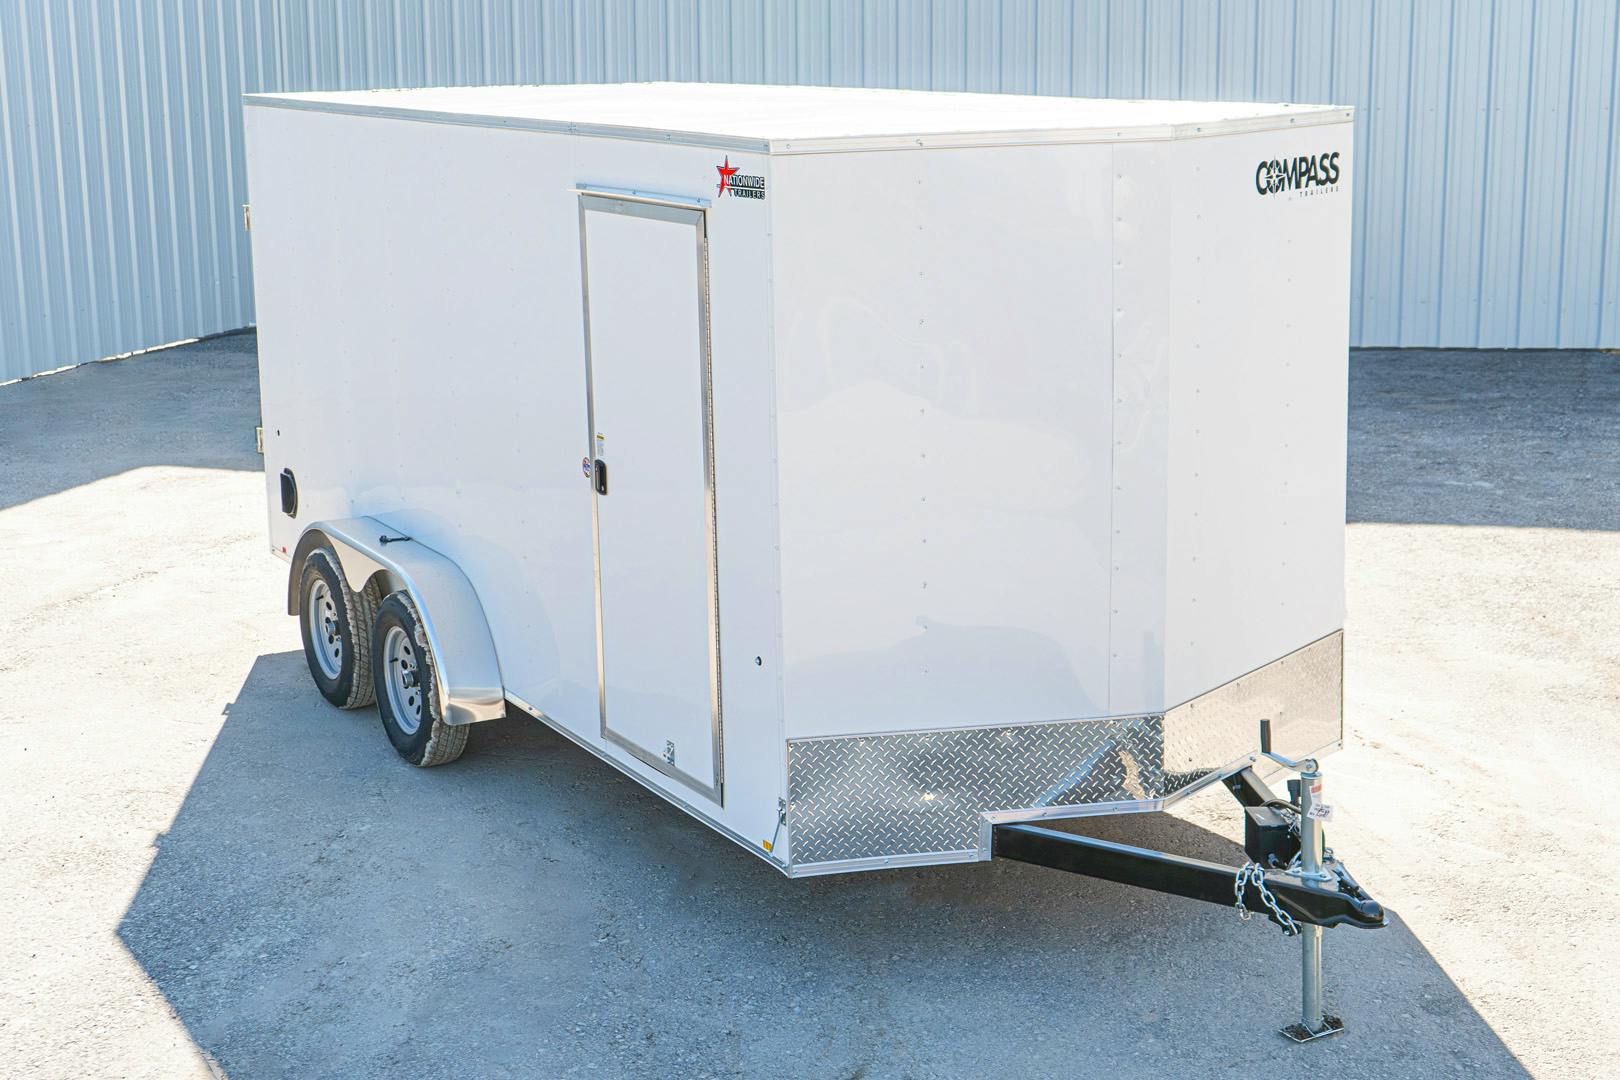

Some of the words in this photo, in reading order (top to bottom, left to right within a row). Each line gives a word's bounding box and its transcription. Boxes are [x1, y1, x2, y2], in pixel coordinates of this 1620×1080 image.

[1256, 152, 1340, 195] COMPASS
[723, 174, 765, 188] NATIONWIDE
[734, 188, 765, 199] TRAILERS
